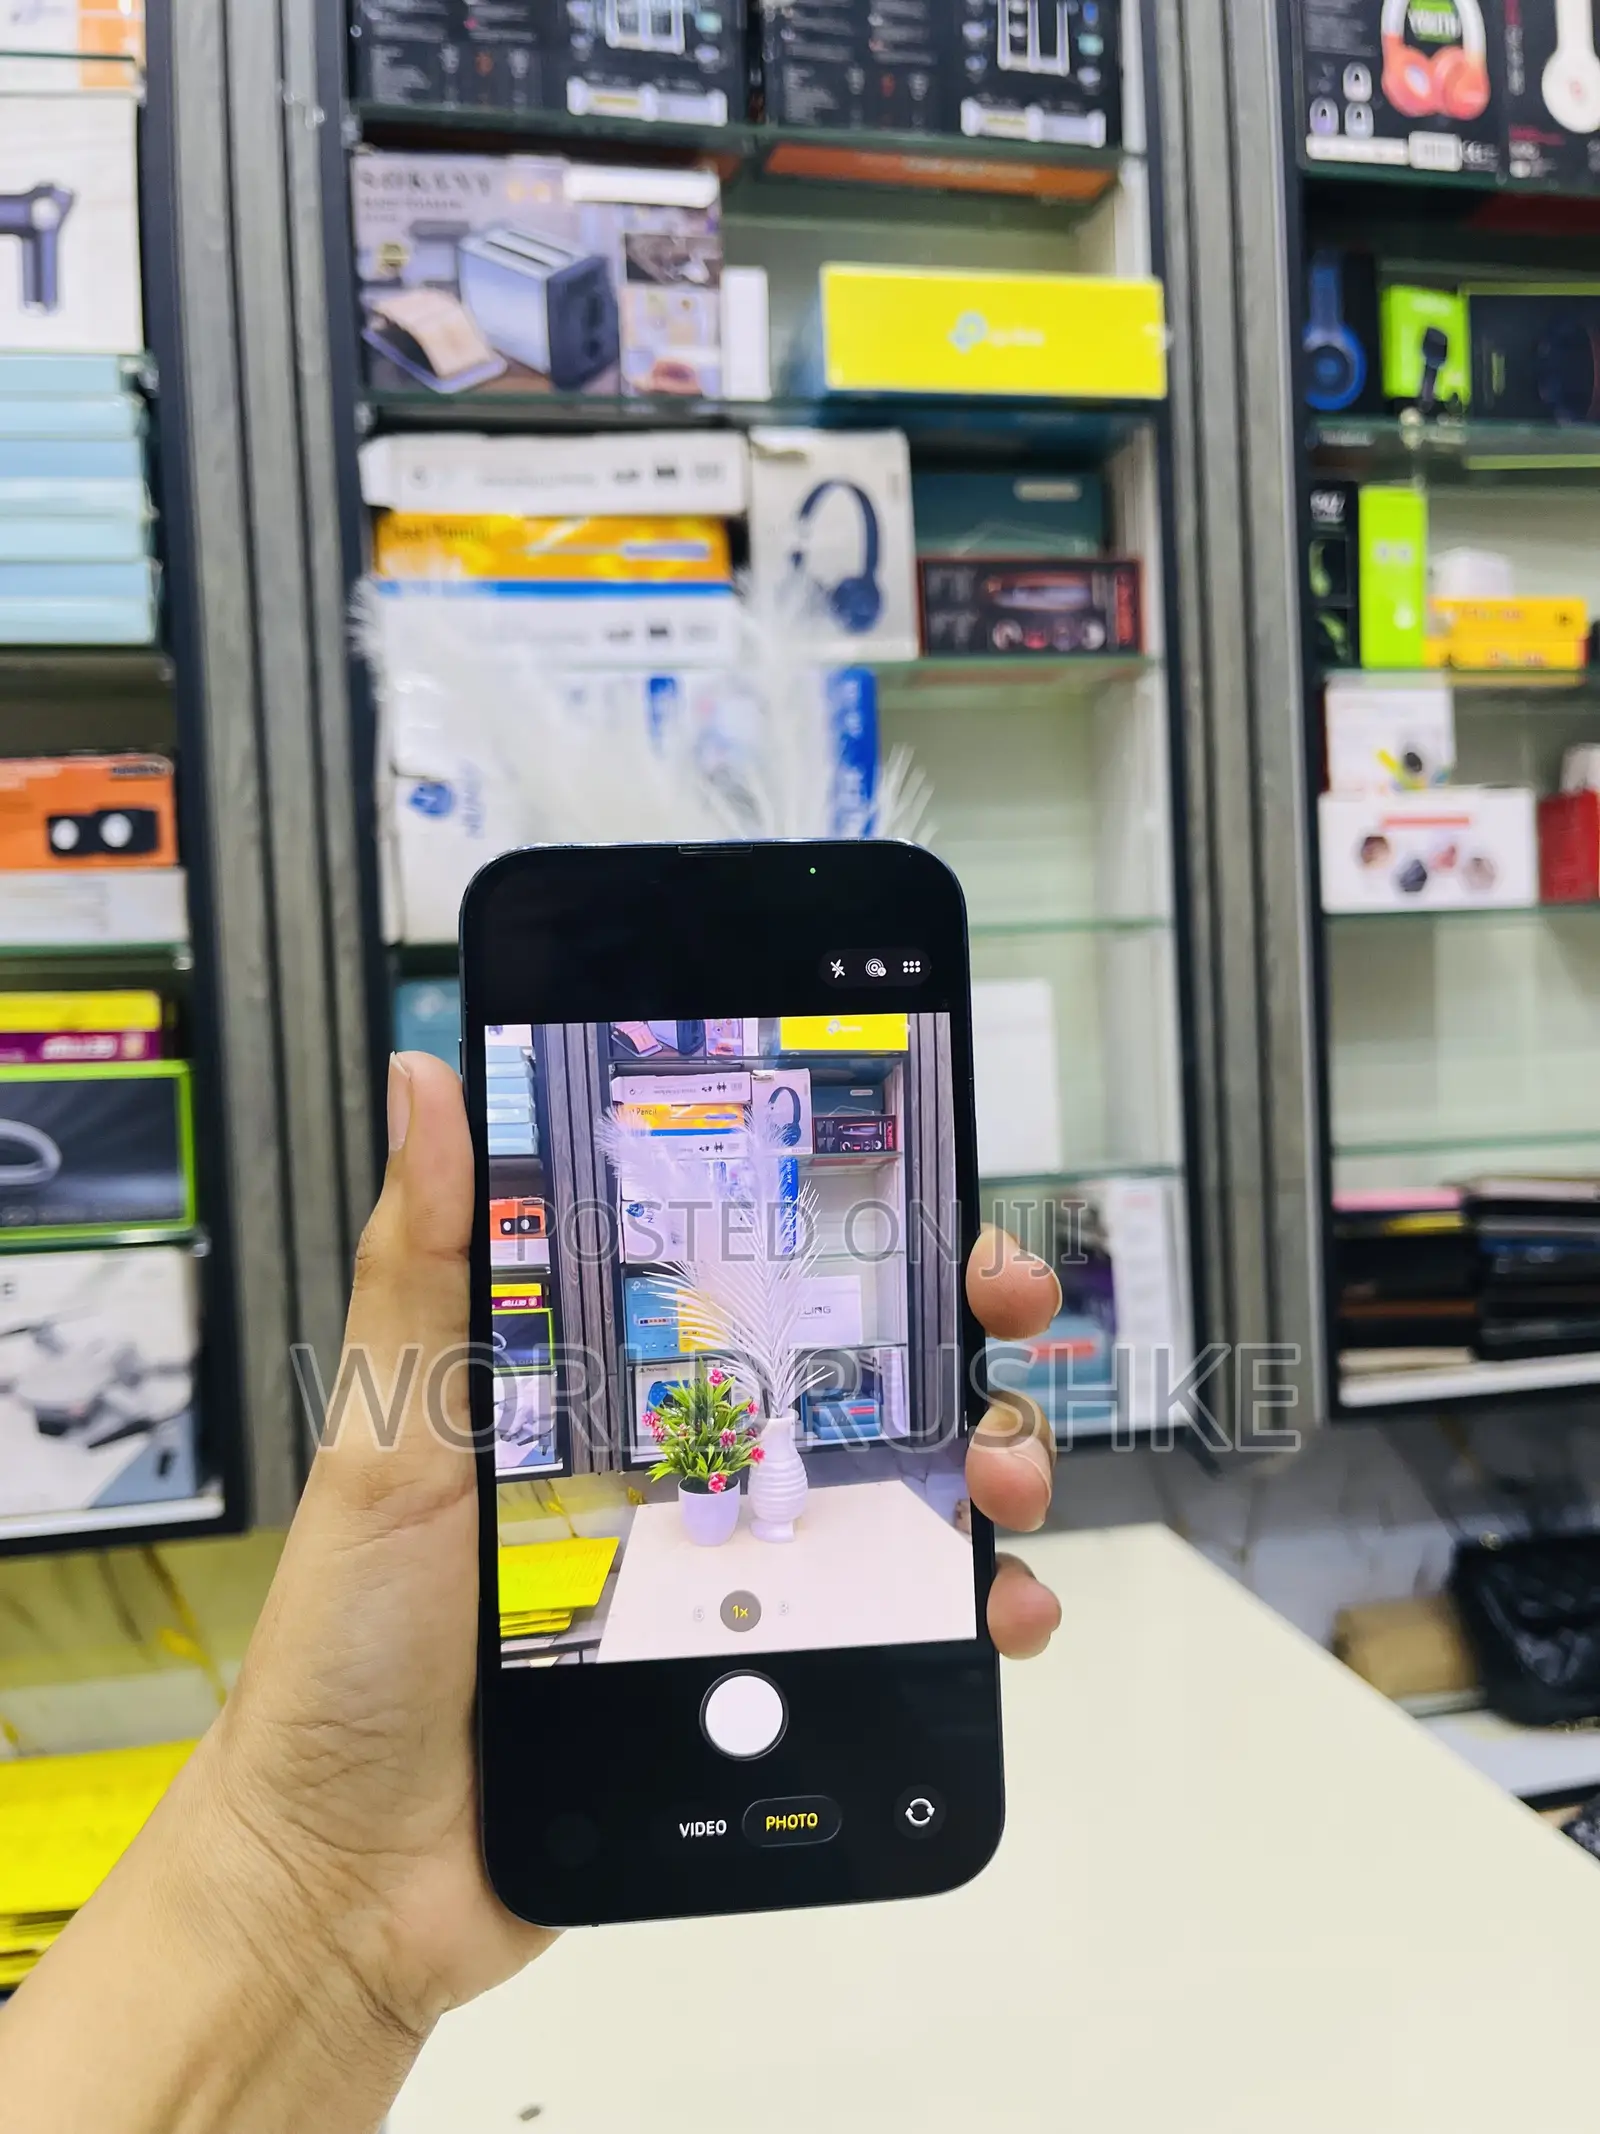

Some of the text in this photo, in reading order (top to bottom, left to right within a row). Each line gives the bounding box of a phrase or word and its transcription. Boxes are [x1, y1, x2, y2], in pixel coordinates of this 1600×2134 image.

[732, 1604, 749, 1619] 1x
[679, 1811, 819, 1839] VIDEO PHOTO
